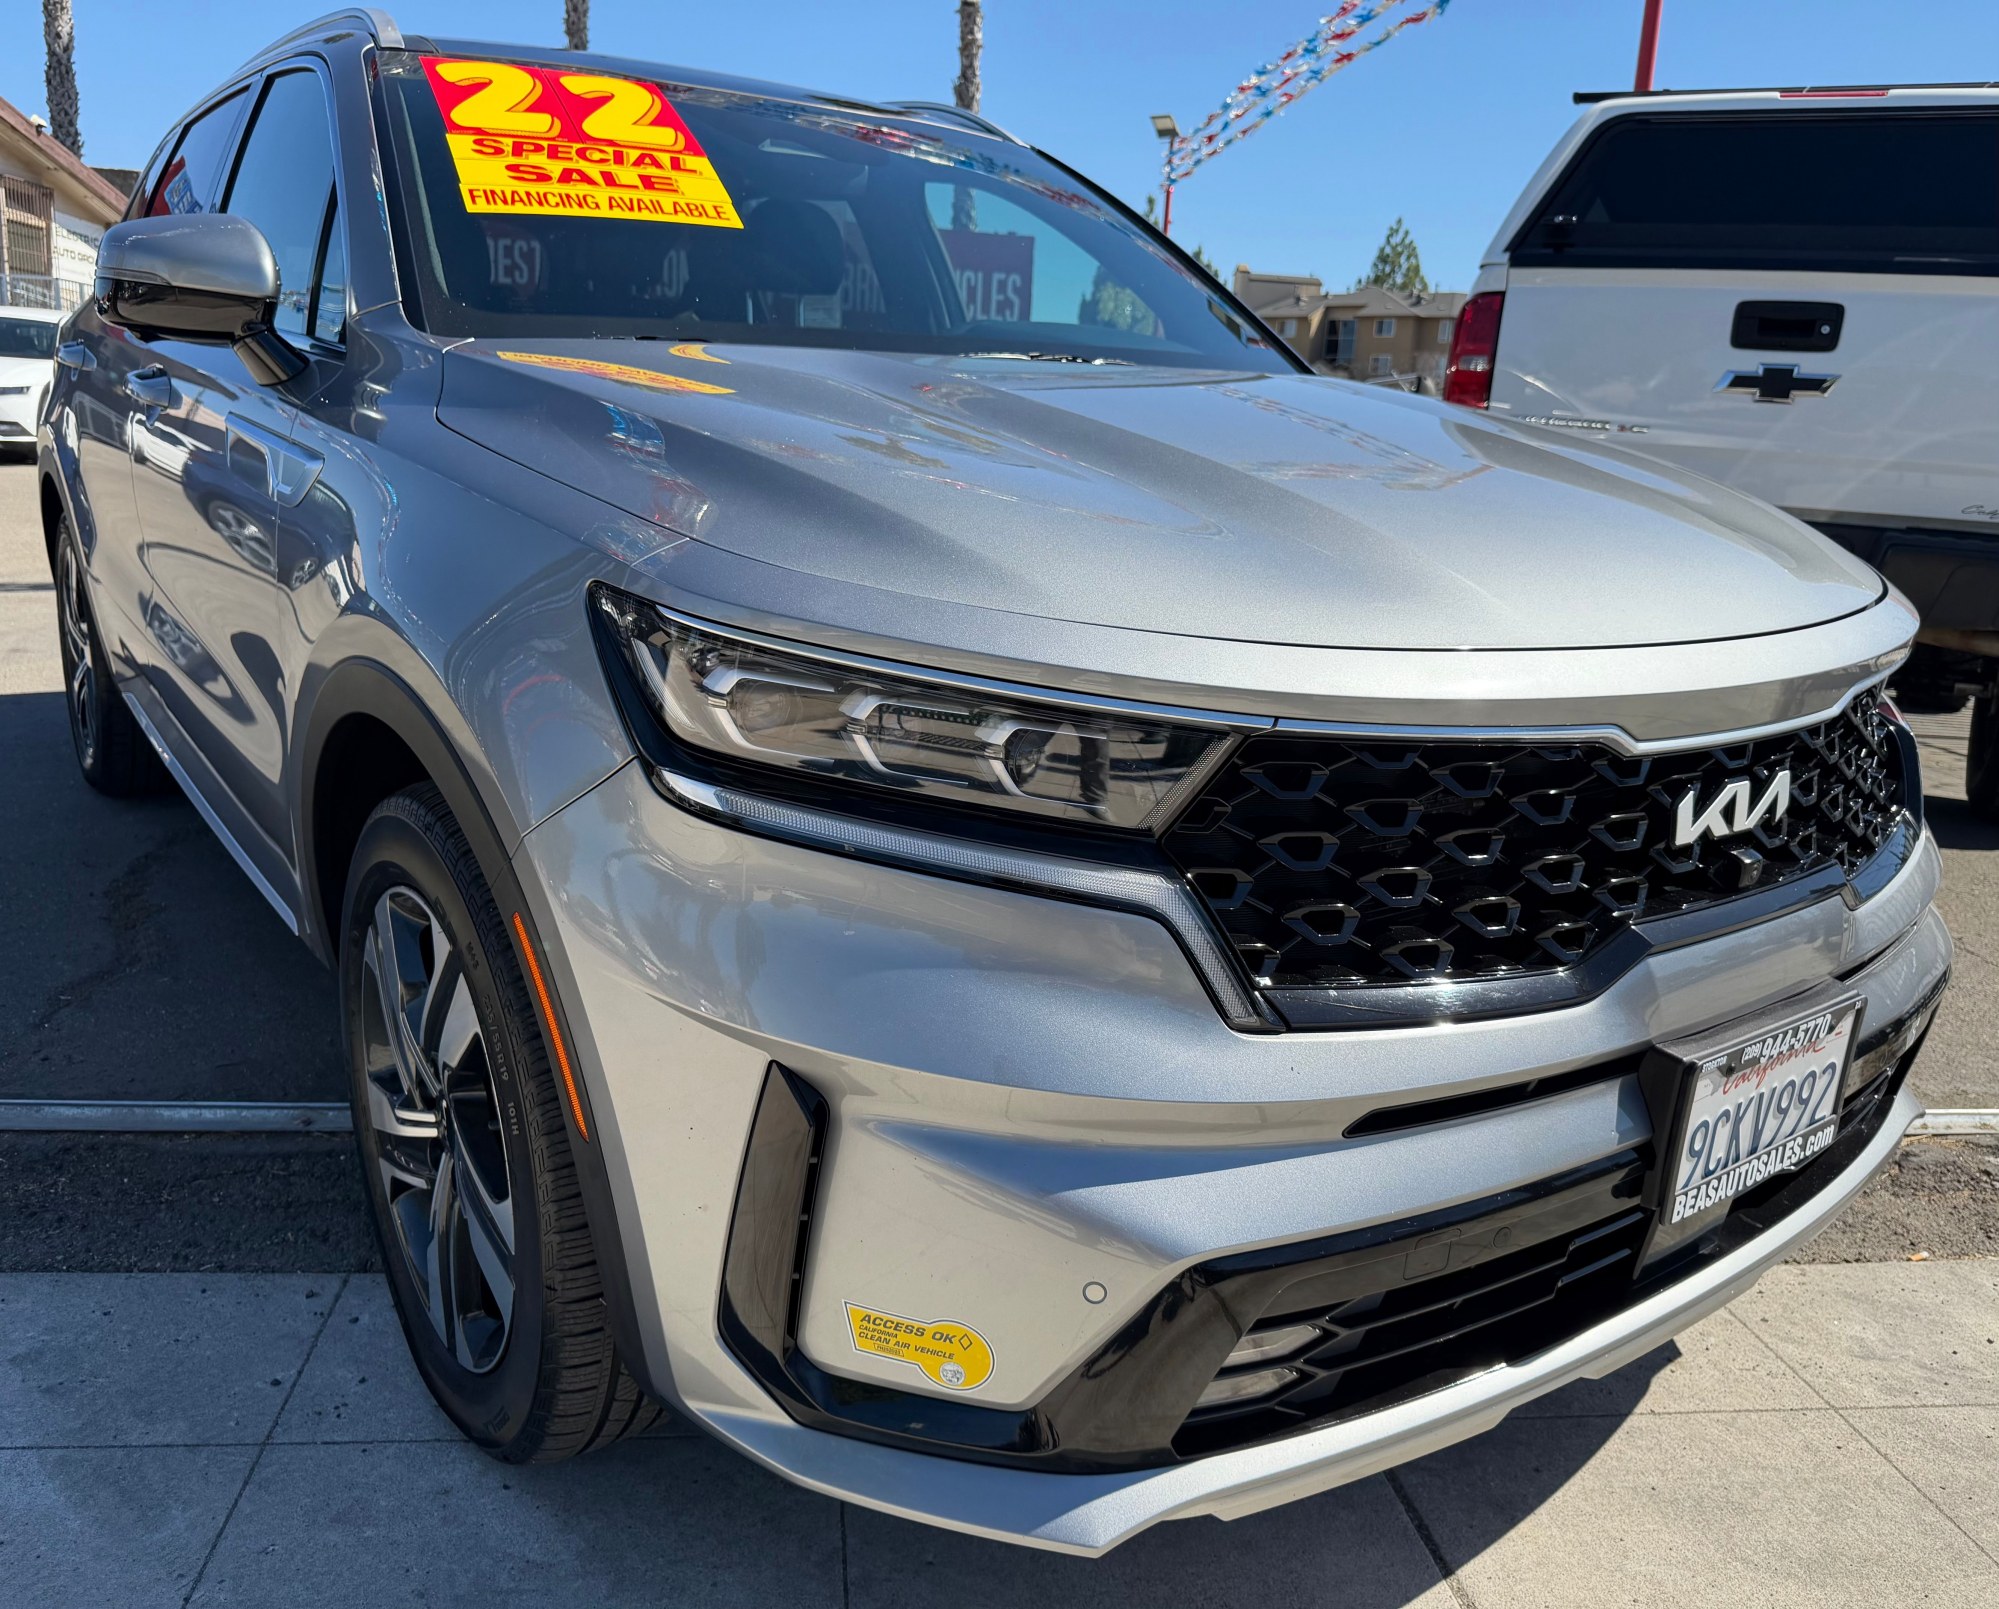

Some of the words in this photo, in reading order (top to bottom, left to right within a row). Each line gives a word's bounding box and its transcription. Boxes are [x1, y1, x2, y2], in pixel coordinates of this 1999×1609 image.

[435, 61, 687, 151] 22
[471, 137, 703, 176] SPECIAL
[505, 164, 684, 195] SALE
[467, 188, 600, 211] FINANCING
[608, 196, 732, 222] AVAILABLE
[1675, 769, 1791, 846] KIA
[1741, 1042, 1762, 1064] (209)
[1760, 1013, 1832, 1063] 944-5770
[1681, 1061, 1837, 1190] 9CKV992
[1672, 1124, 1835, 1223] BEASAUTOSALES.com
[858, 1324, 898, 1339] CALIFORNIA
[858, 1331, 891, 1345] CLEAN
[893, 1340, 911, 1350] AIR
[914, 1345, 955, 1360] VEHICLE
[860, 1314, 926, 1337] ACCESS
[931, 1331, 957, 1344] OK
